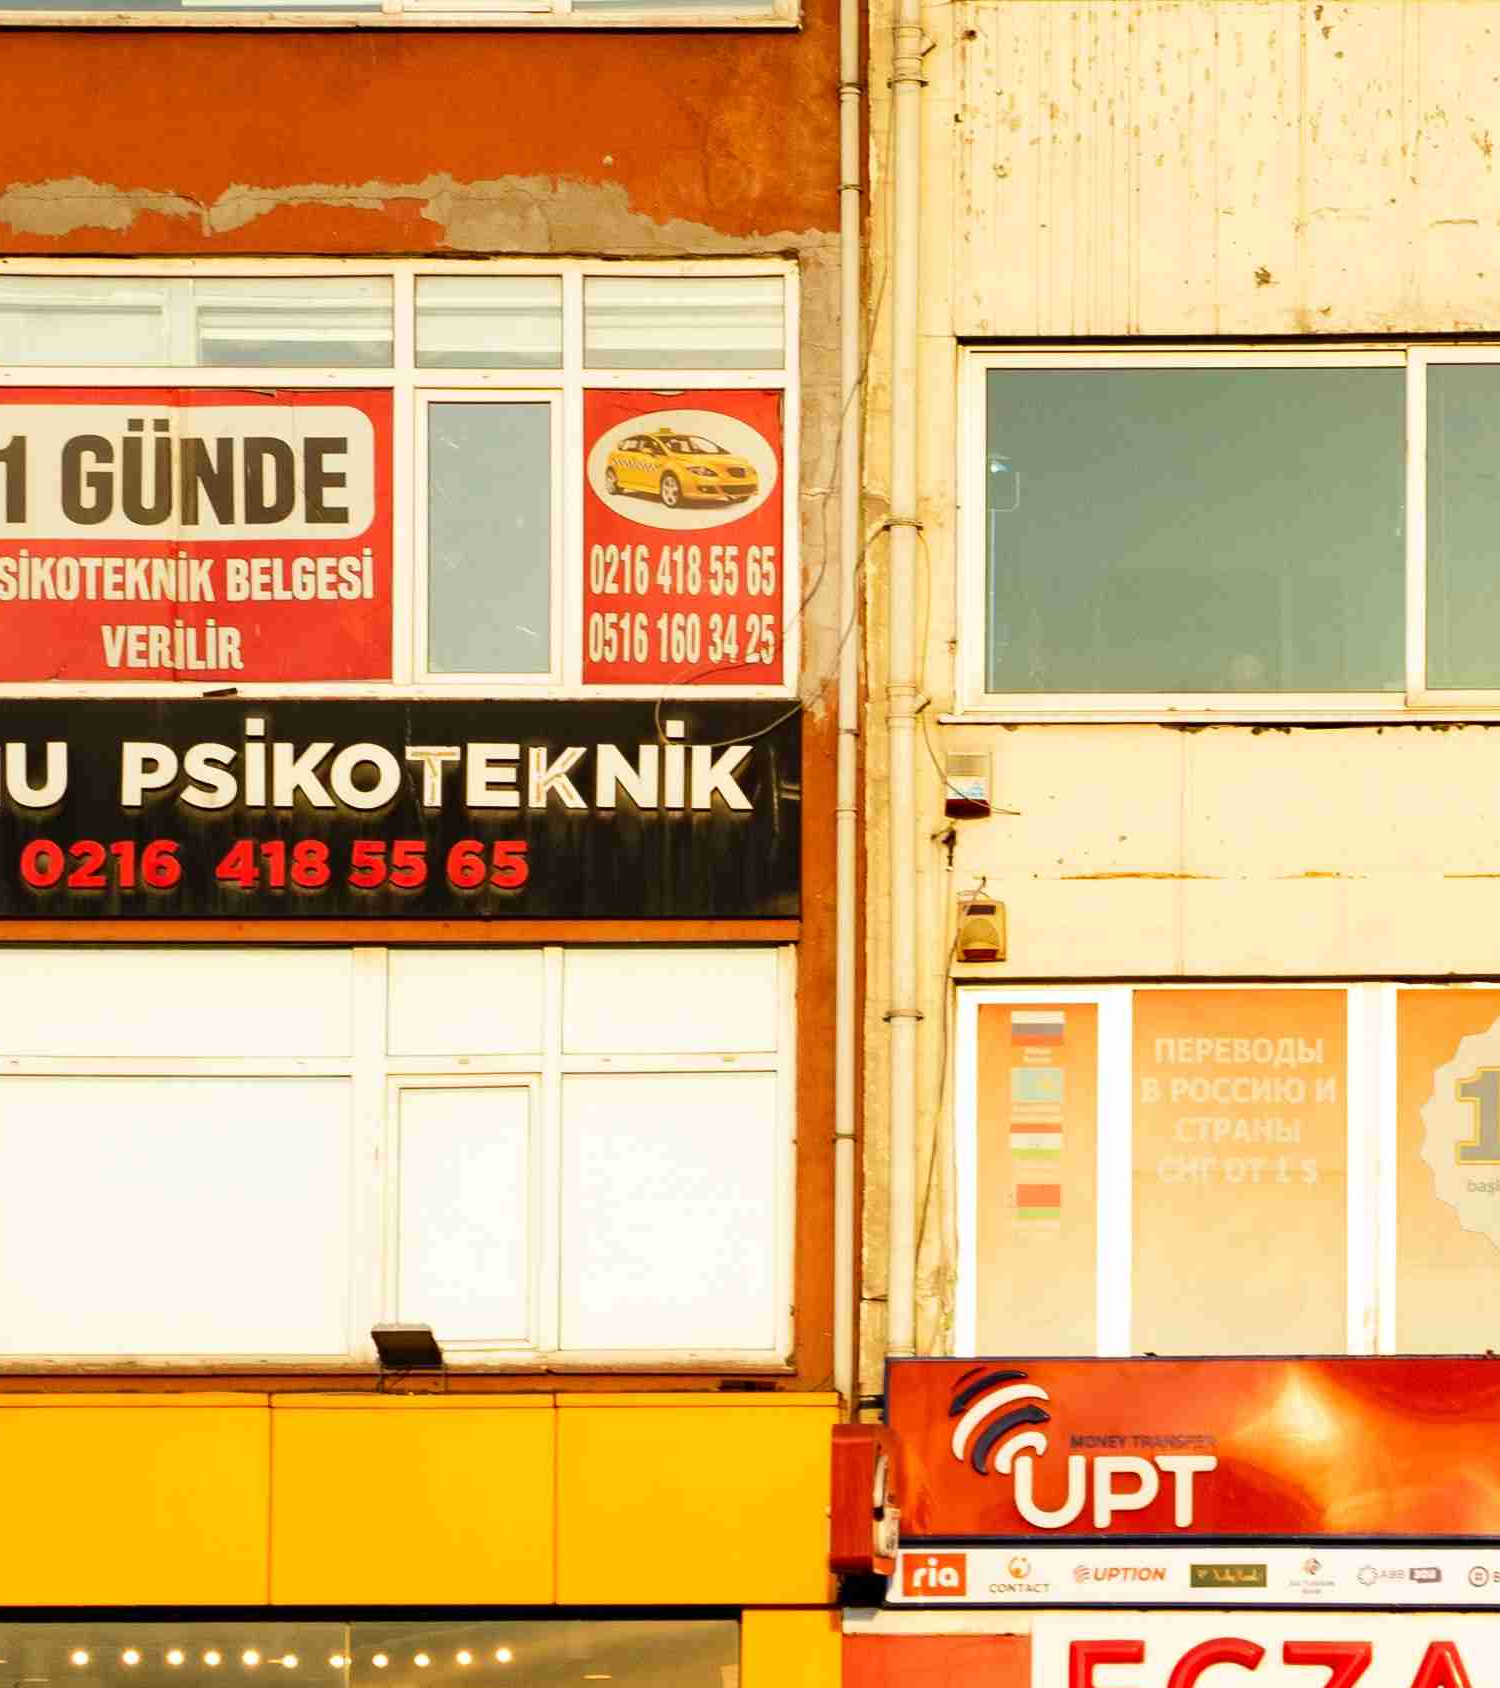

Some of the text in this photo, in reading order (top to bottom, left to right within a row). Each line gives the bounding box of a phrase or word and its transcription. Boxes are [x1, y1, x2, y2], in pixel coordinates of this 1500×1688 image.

[61, 418, 350, 525] GÜNDE
[226, 550, 375, 602] BELGESİ
[590, 544, 776, 598] 0216 418 55 65
[100, 619, 244, 673] VERİLİR
[588, 612, 775, 666] 0516 160 34 25
[121, 719, 754, 810] PSİKOTEKNİK
[21, 838, 530, 890] 0216 418 55 65
[1155, 1037, 1325, 1068] ПЕРЕВОДЫ
[1140, 1076, 1337, 1104] В РОССИЮ И
[1174, 1117, 1301, 1144] СТРАНЫ
[1069, 1434, 1218, 1450] MONEY TRANSFER
[1012, 1455, 1215, 1530] UPT
[912, 1557, 960, 1589] ria
[988, 1583, 1051, 1594] CONTACT
[1092, 1567, 1167, 1583] UPTION
